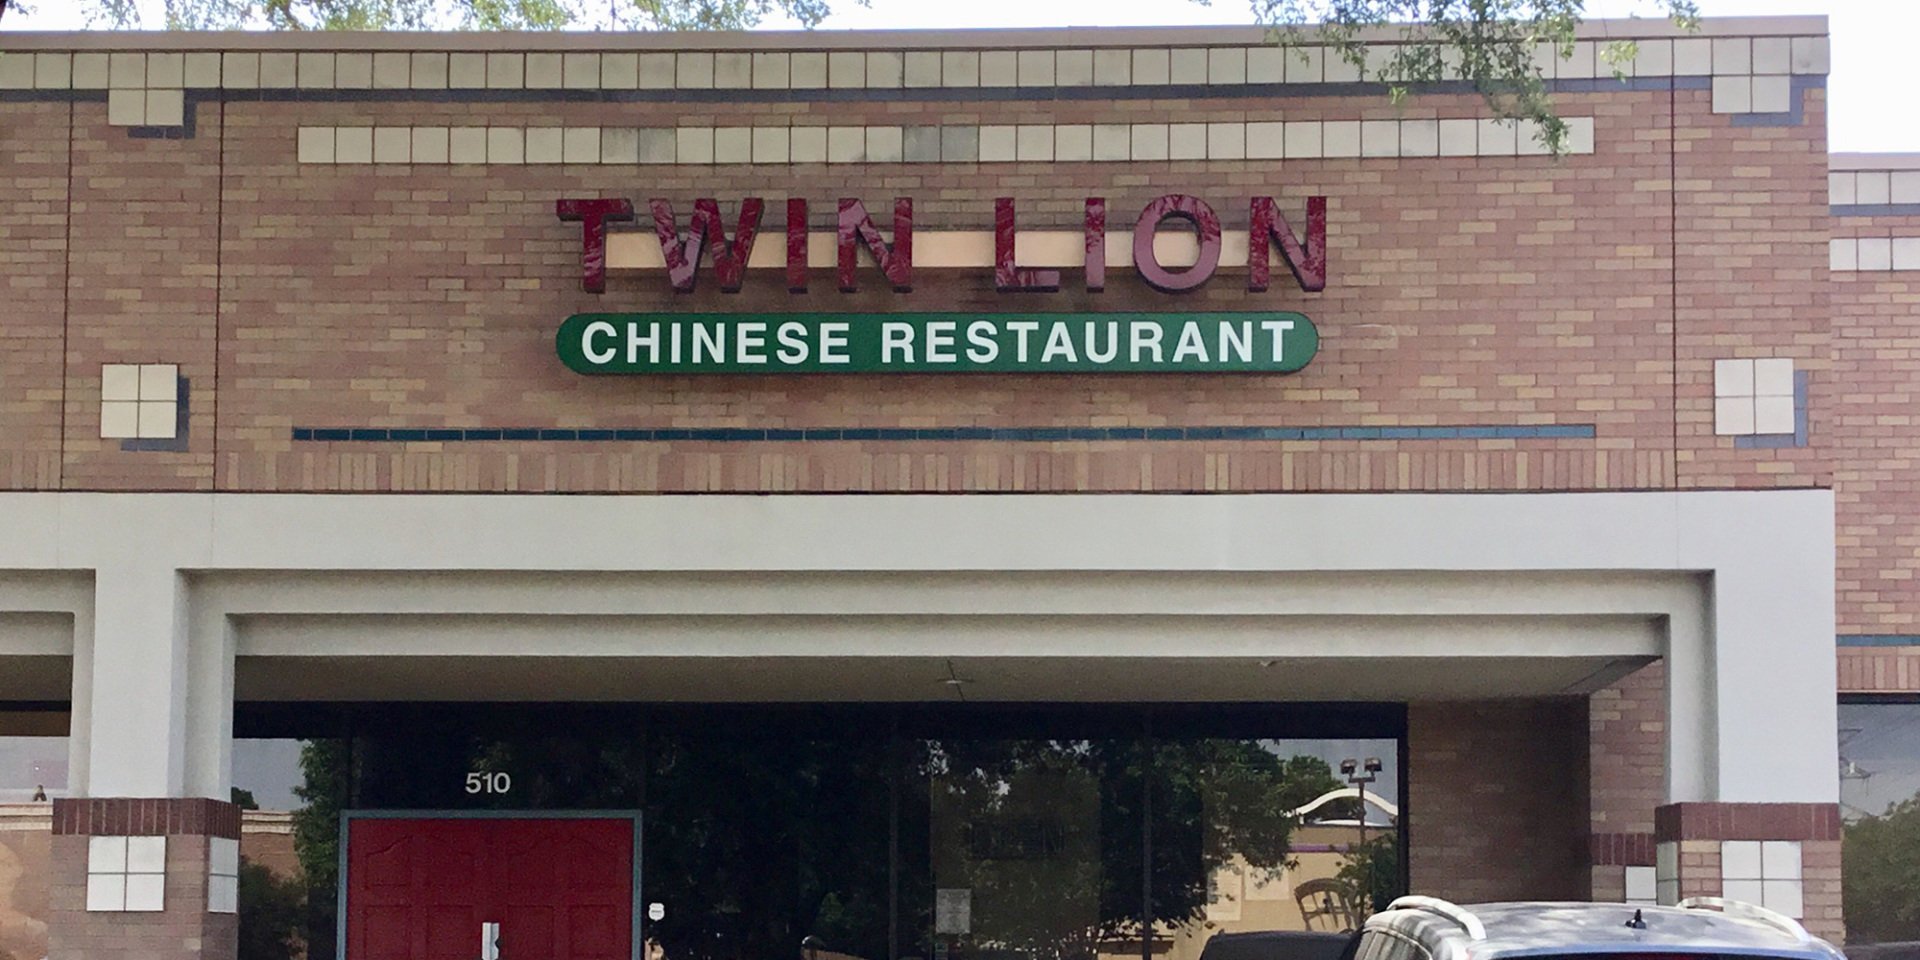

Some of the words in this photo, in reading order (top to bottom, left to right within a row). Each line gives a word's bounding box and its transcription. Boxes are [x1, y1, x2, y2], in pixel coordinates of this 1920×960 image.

[557, 197, 914, 294] TWIN
[994, 194, 1328, 293] LION
[581, 321, 850, 365] CHINESE
[882, 319, 1295, 363] RESTAURANT
[465, 772, 511, 794] 510
